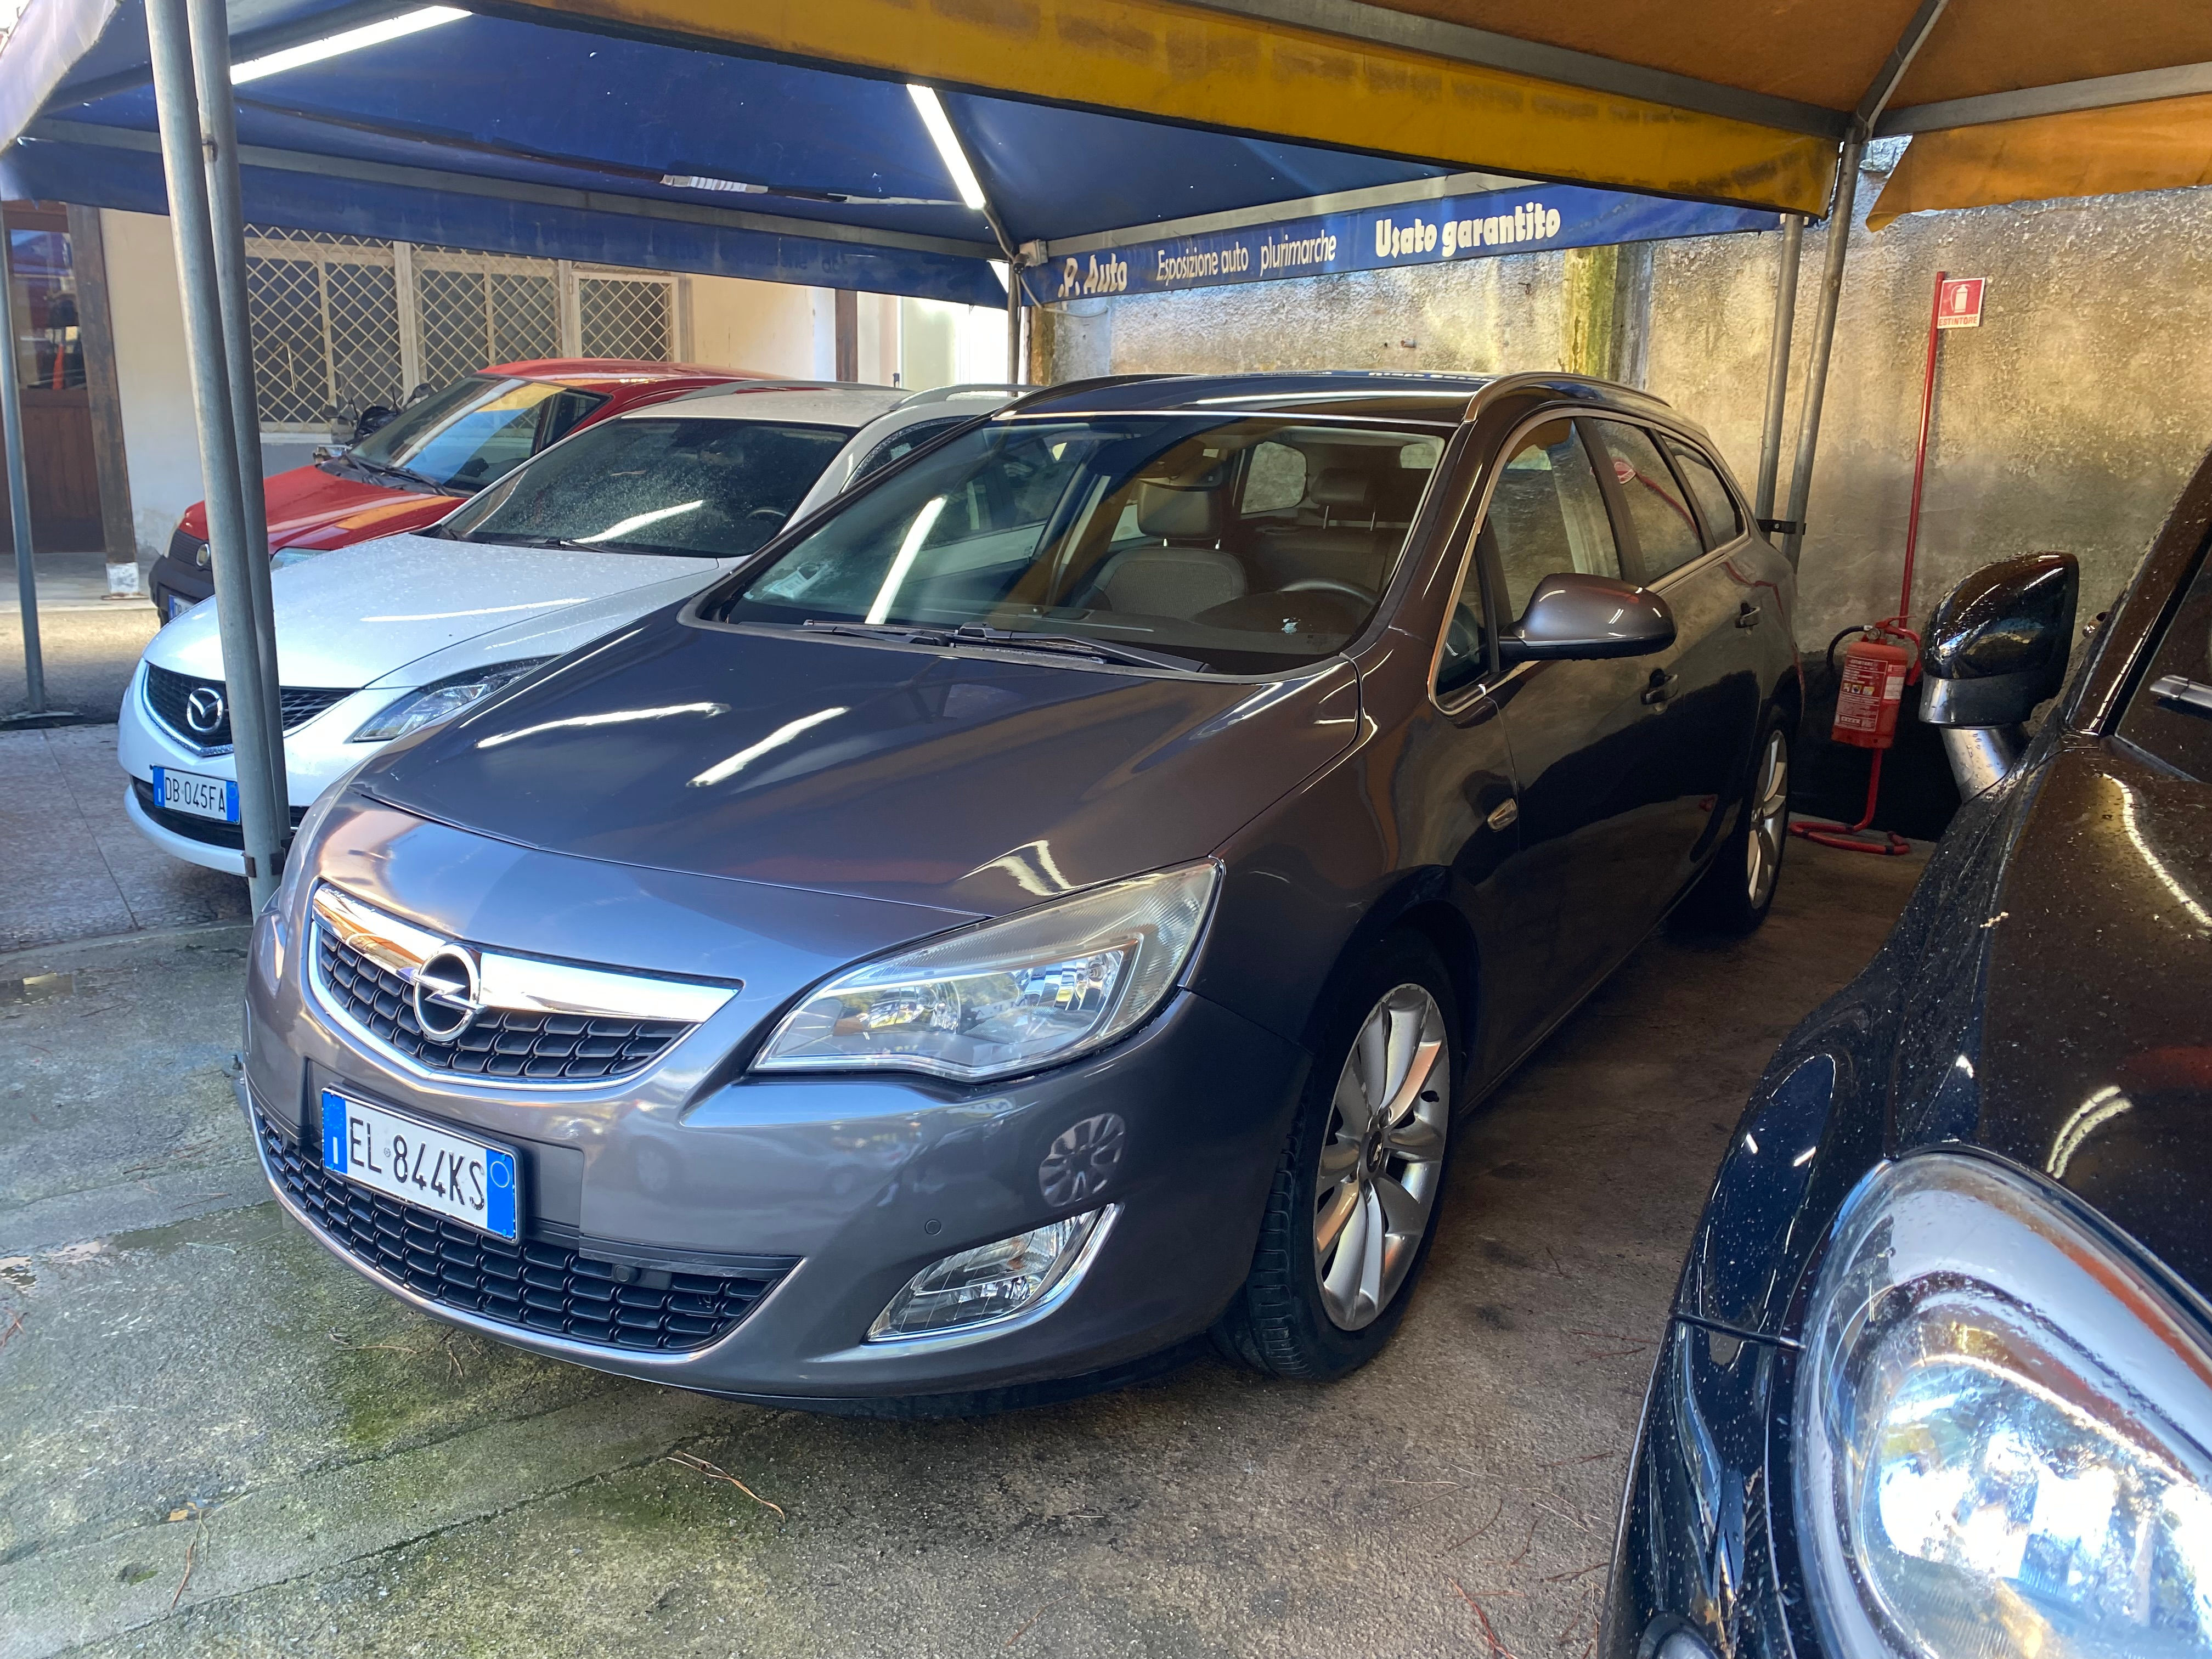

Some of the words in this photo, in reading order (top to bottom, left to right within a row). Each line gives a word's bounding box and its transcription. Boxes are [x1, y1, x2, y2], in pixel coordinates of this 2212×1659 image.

[1375, 218, 1437, 258] Usato
[1442, 202, 1560, 257] garantito
[1084, 253, 1127, 294] Auto
[1156, 247, 1218, 285] Esposizione
[1221, 241, 1248, 274] auto
[1260, 229, 1336, 276] plurimarche
[1939, 316, 1977, 326] ESTINTORE
